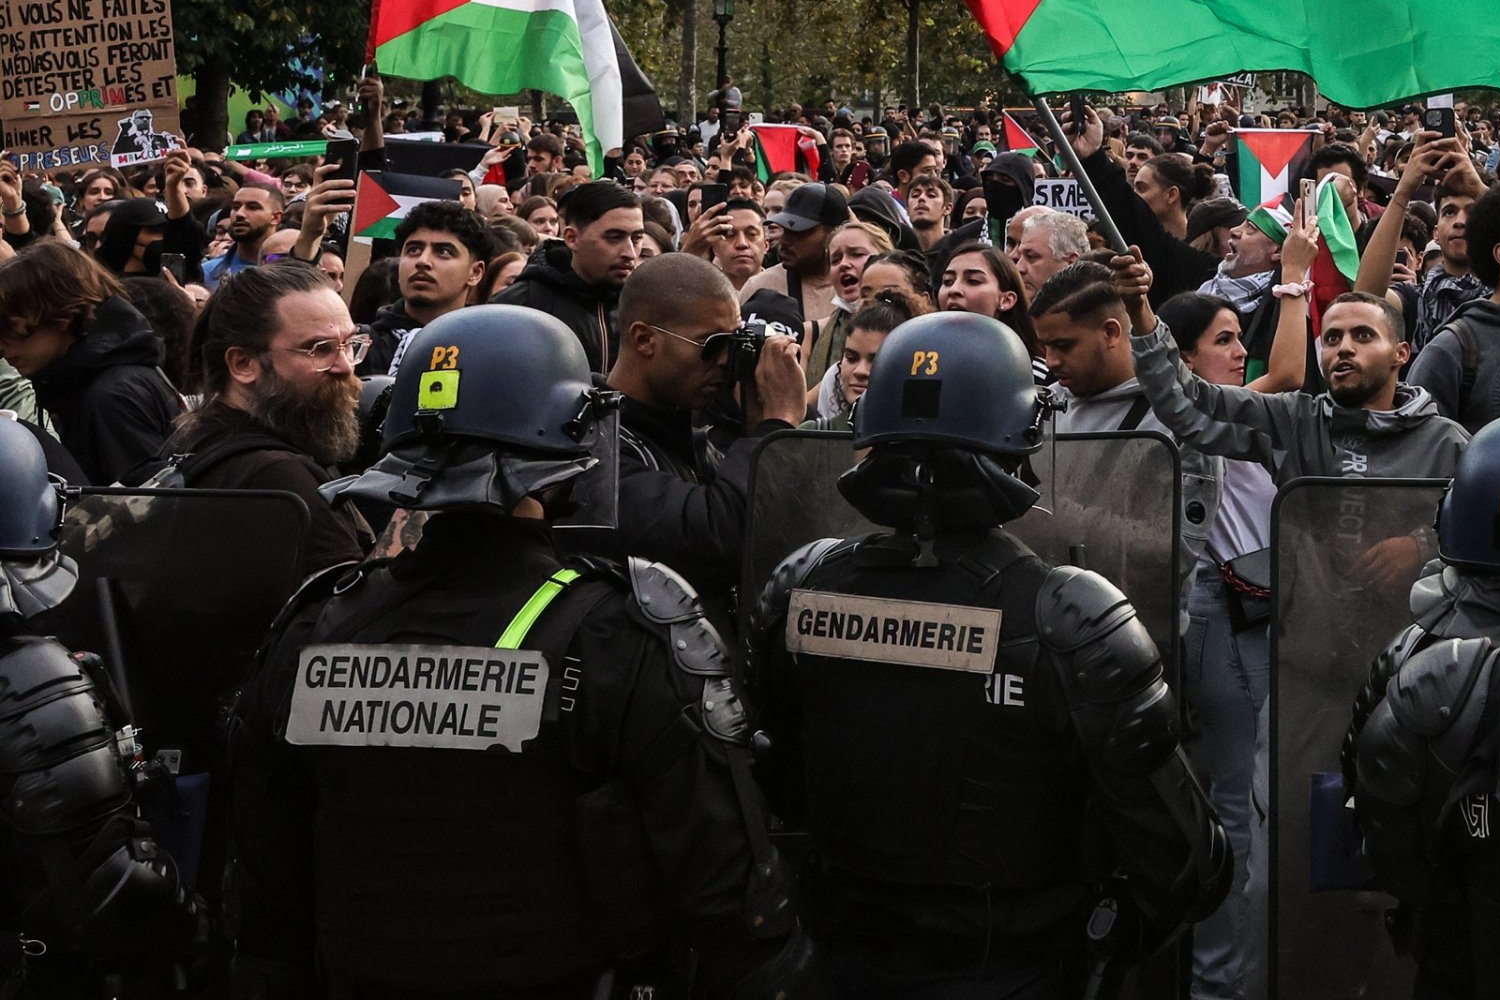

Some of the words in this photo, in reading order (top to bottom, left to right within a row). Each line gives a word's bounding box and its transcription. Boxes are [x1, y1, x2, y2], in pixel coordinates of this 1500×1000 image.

[18, 0, 63, 26] VOUS
[0, 31, 26, 53] PAS
[138, 15, 170, 41] LES
[53, 46, 100, 71] VOUS
[107, 38, 172, 65] FERONT
[2, 68, 96, 100] DÉTESTER
[103, 62, 143, 87] LES
[152, 75, 174, 98] ET
[67, 118, 103, 143] LES
[9, 142, 110, 172] OPPRESSEURS
[1035, 184, 1088, 207] SRAE
[430, 345, 459, 370] P3
[911, 351, 939, 376] P3
[797, 608, 985, 655] GENDARMERIE
[305, 655, 539, 695] GENDARMERIE
[319, 700, 501, 738] NATIONALE
